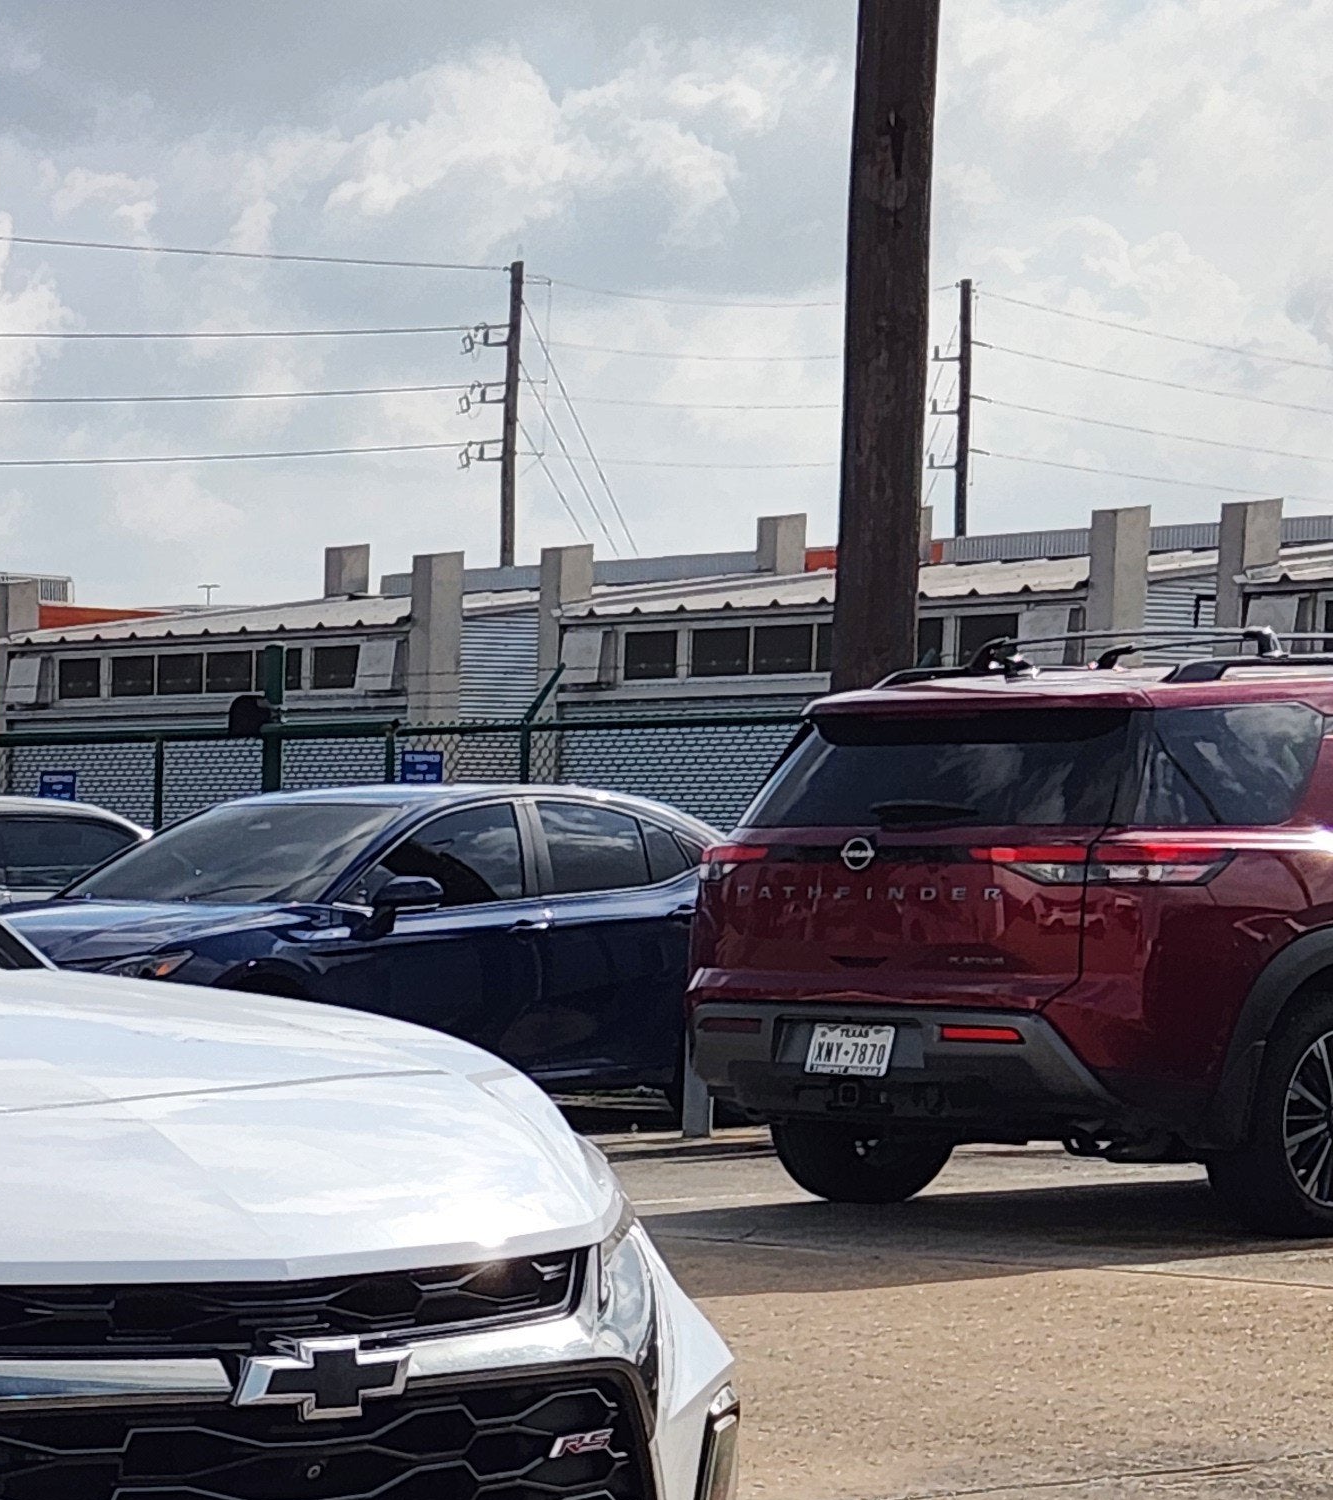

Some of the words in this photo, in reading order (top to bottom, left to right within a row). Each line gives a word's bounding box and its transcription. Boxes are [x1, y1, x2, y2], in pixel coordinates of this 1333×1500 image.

[736, 885, 1003, 901] PATHFINDER
[840, 1028, 869, 1039] TEXAS
[549, 1427, 613, 1458] RS
